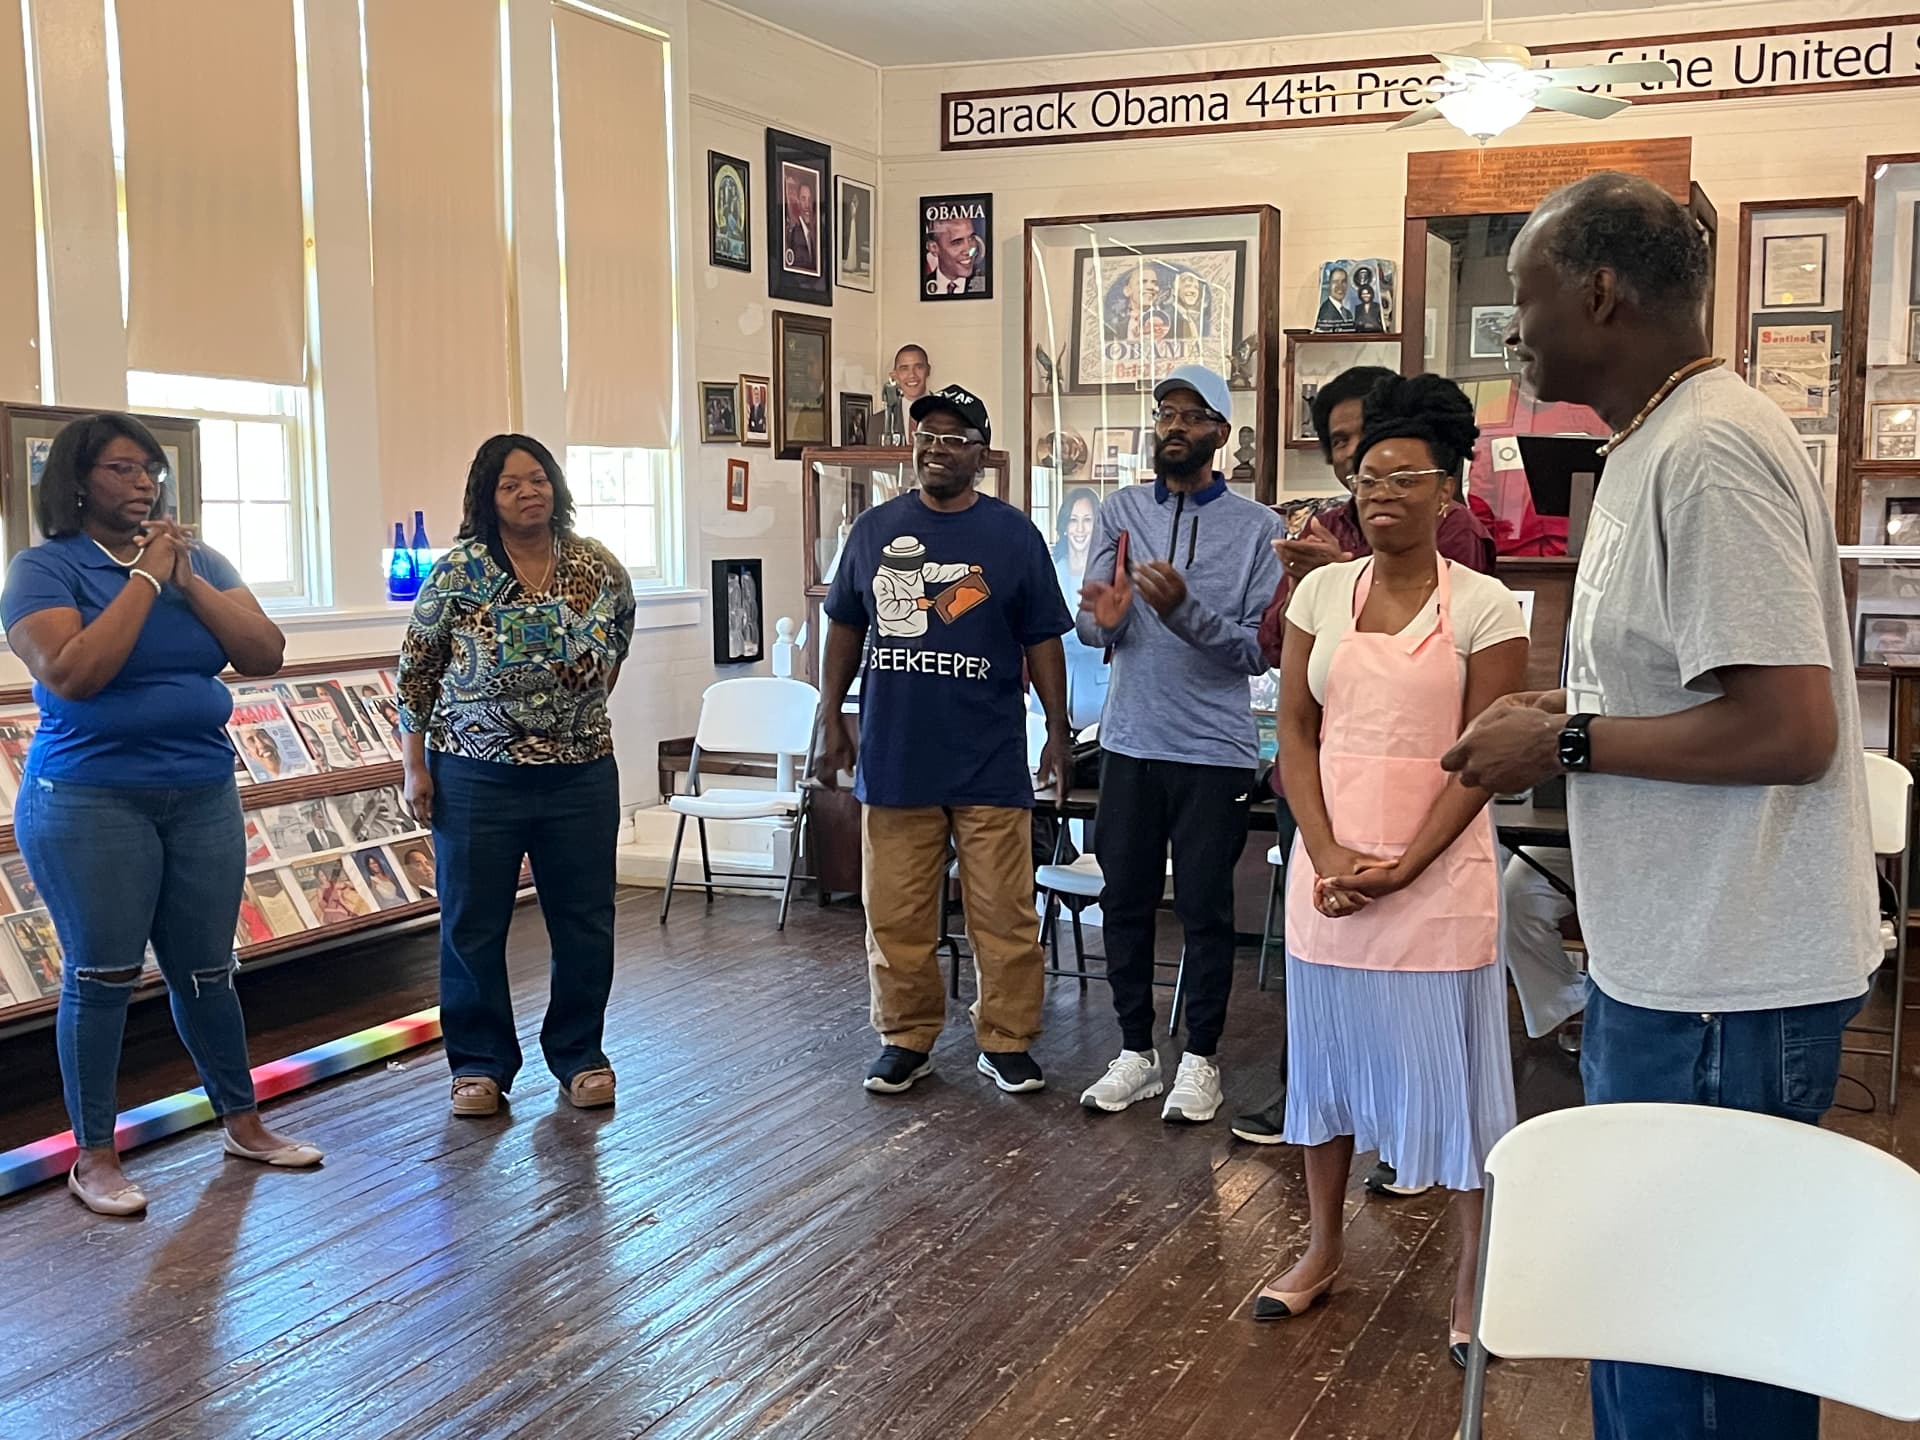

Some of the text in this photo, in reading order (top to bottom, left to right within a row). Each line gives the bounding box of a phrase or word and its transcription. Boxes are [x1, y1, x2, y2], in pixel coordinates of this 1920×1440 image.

[952, 92, 1077, 136] Barack
[1091, 89, 1229, 127] Obama
[1245, 74, 1337, 118] 44th
[1734, 31, 1893, 84] United
[926, 204, 986, 221] OBAMA
[1761, 331, 1810, 344] Sentinel
[1104, 340, 1201, 361] OBAMA
[870, 646, 990, 680] BEEKEEPER
[299, 706, 331, 723] TIME
